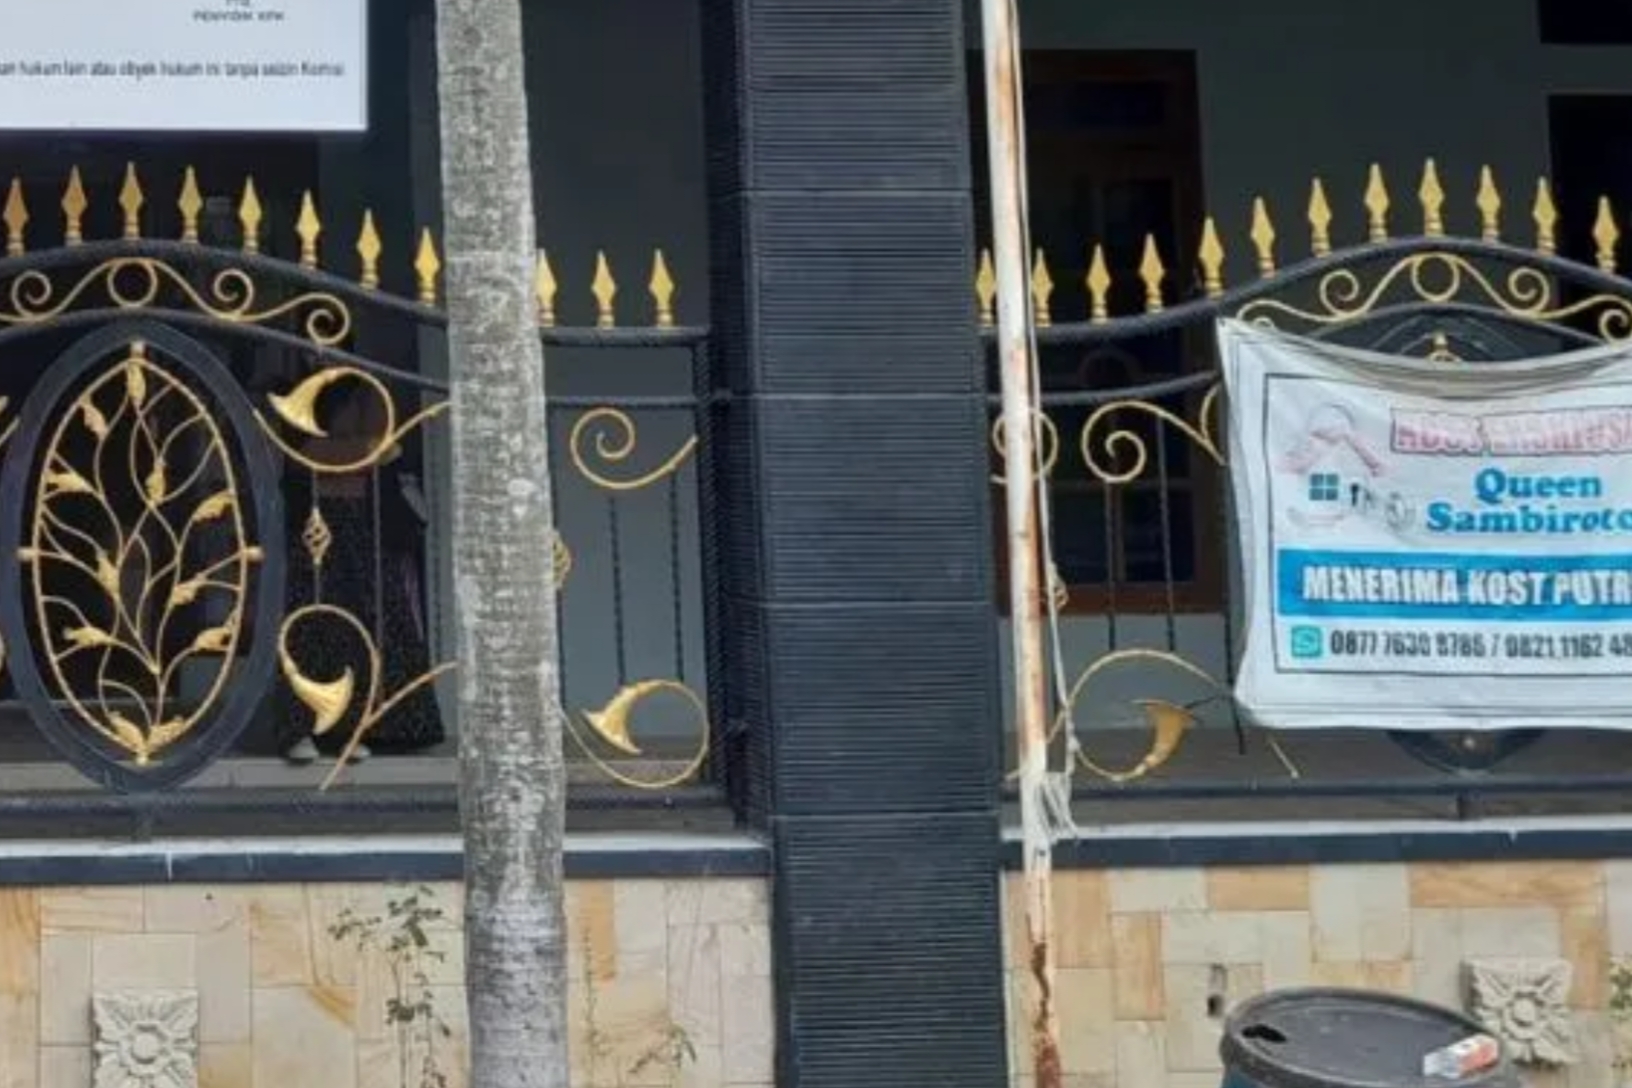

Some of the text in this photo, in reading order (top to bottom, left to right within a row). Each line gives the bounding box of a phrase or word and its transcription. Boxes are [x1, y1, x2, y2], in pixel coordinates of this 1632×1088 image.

[1475, 467, 1602, 504] Queen
[1303, 565, 1460, 603] MENERIMA
[1468, 569, 1545, 605] KOST
[1330, 629, 1377, 655] 0877
